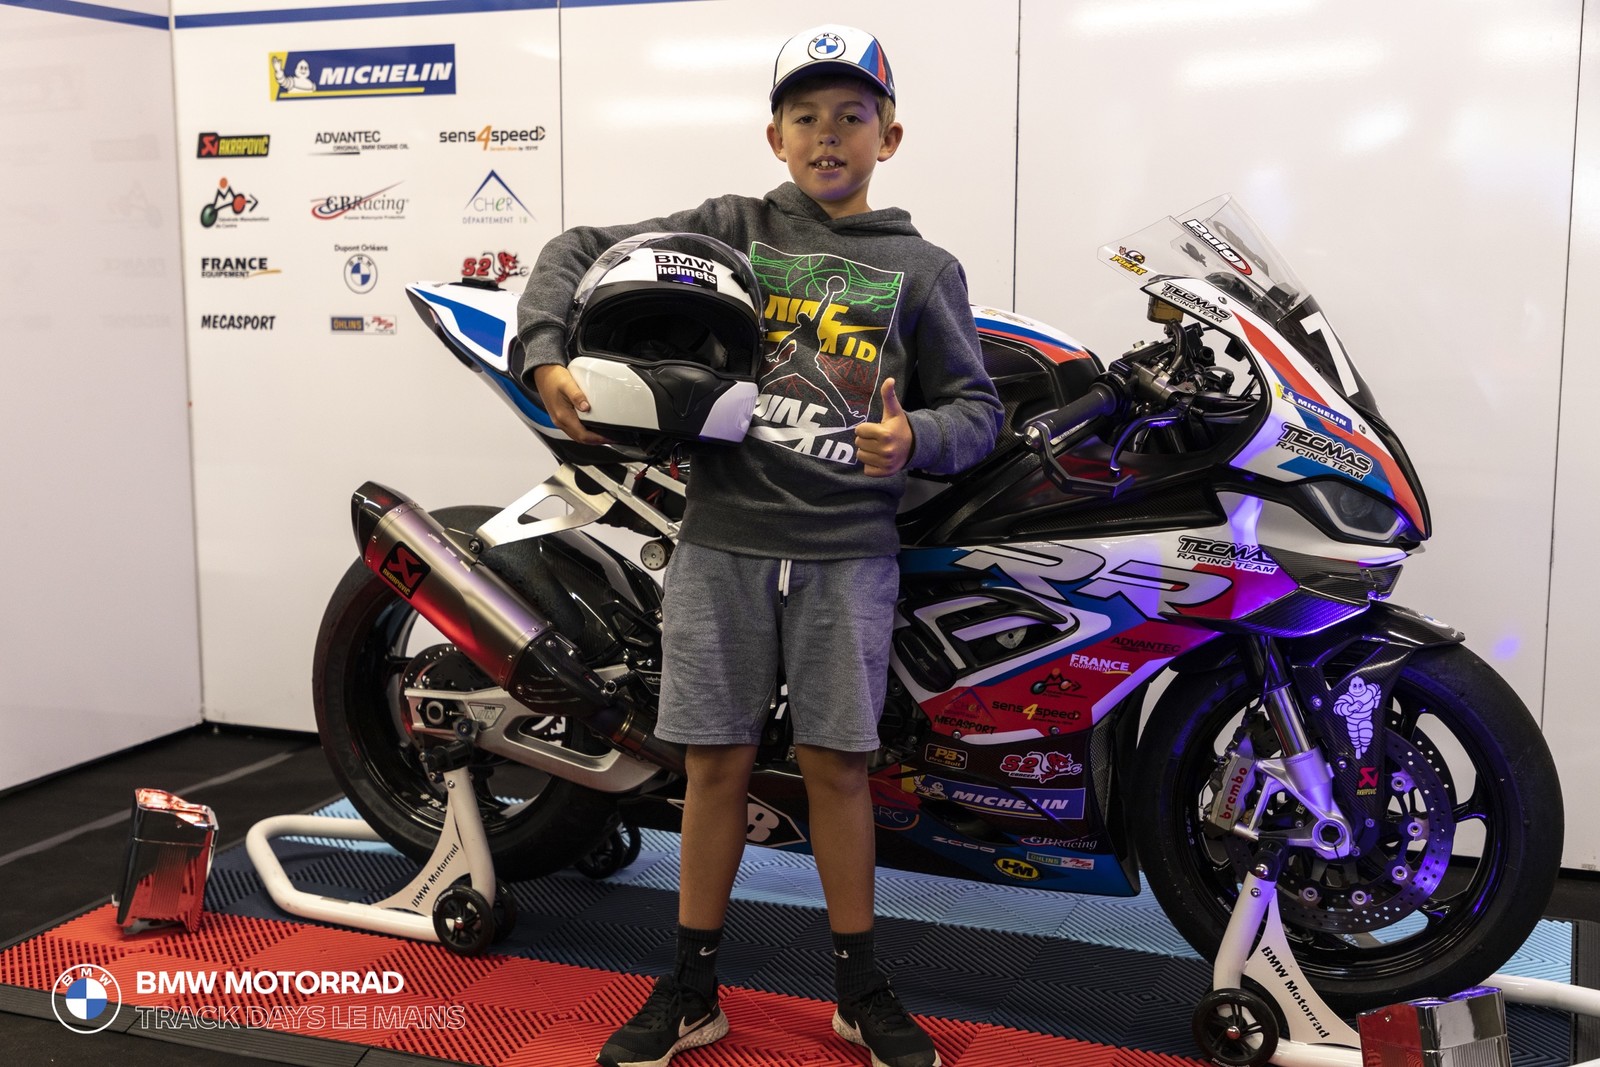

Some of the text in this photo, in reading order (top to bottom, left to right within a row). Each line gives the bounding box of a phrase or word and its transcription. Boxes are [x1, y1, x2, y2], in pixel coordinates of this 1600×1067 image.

[318, 61, 453, 86] MICHELIN
[315, 131, 381, 144] ADVANTEC
[334, 244, 359, 252] Dupont
[1182, 218, 1246, 268] Puig
[201, 257, 268, 270] FRANCE
[462, 257, 491, 277] S2
[654, 255, 714, 272] BMW
[201, 271, 250, 279] EQUIPEMENT
[657, 265, 717, 284] helmets
[1161, 282, 1231, 320] TECMAS
[1161, 292, 1223, 324] RACING TEAM
[201, 314, 276, 330] MECASPORT
[1298, 399, 1347, 426] MICHELIN
[1279, 422, 1373, 473] TECMAS
[1276, 441, 1364, 480] RACING TEAM
[1178, 536, 1278, 566] TECMA
[1177, 553, 1275, 573] RACING TEAM
[1110, 636, 1182, 653] ADVANTEC
[1069, 661, 1112, 673] EQUIPEMENT
[1070, 653, 1130, 672] FRANCE
[934, 714, 997, 735] MECASPORT
[1001, 754, 1040, 773] S2
[952, 790, 1069, 811] MICHEIN
[1219, 767, 1248, 819] brembo
[411, 883, 430, 908] BMW
[428, 843, 460, 885] Motorrad
[1261, 946, 1331, 1038] BMW Motorrad
